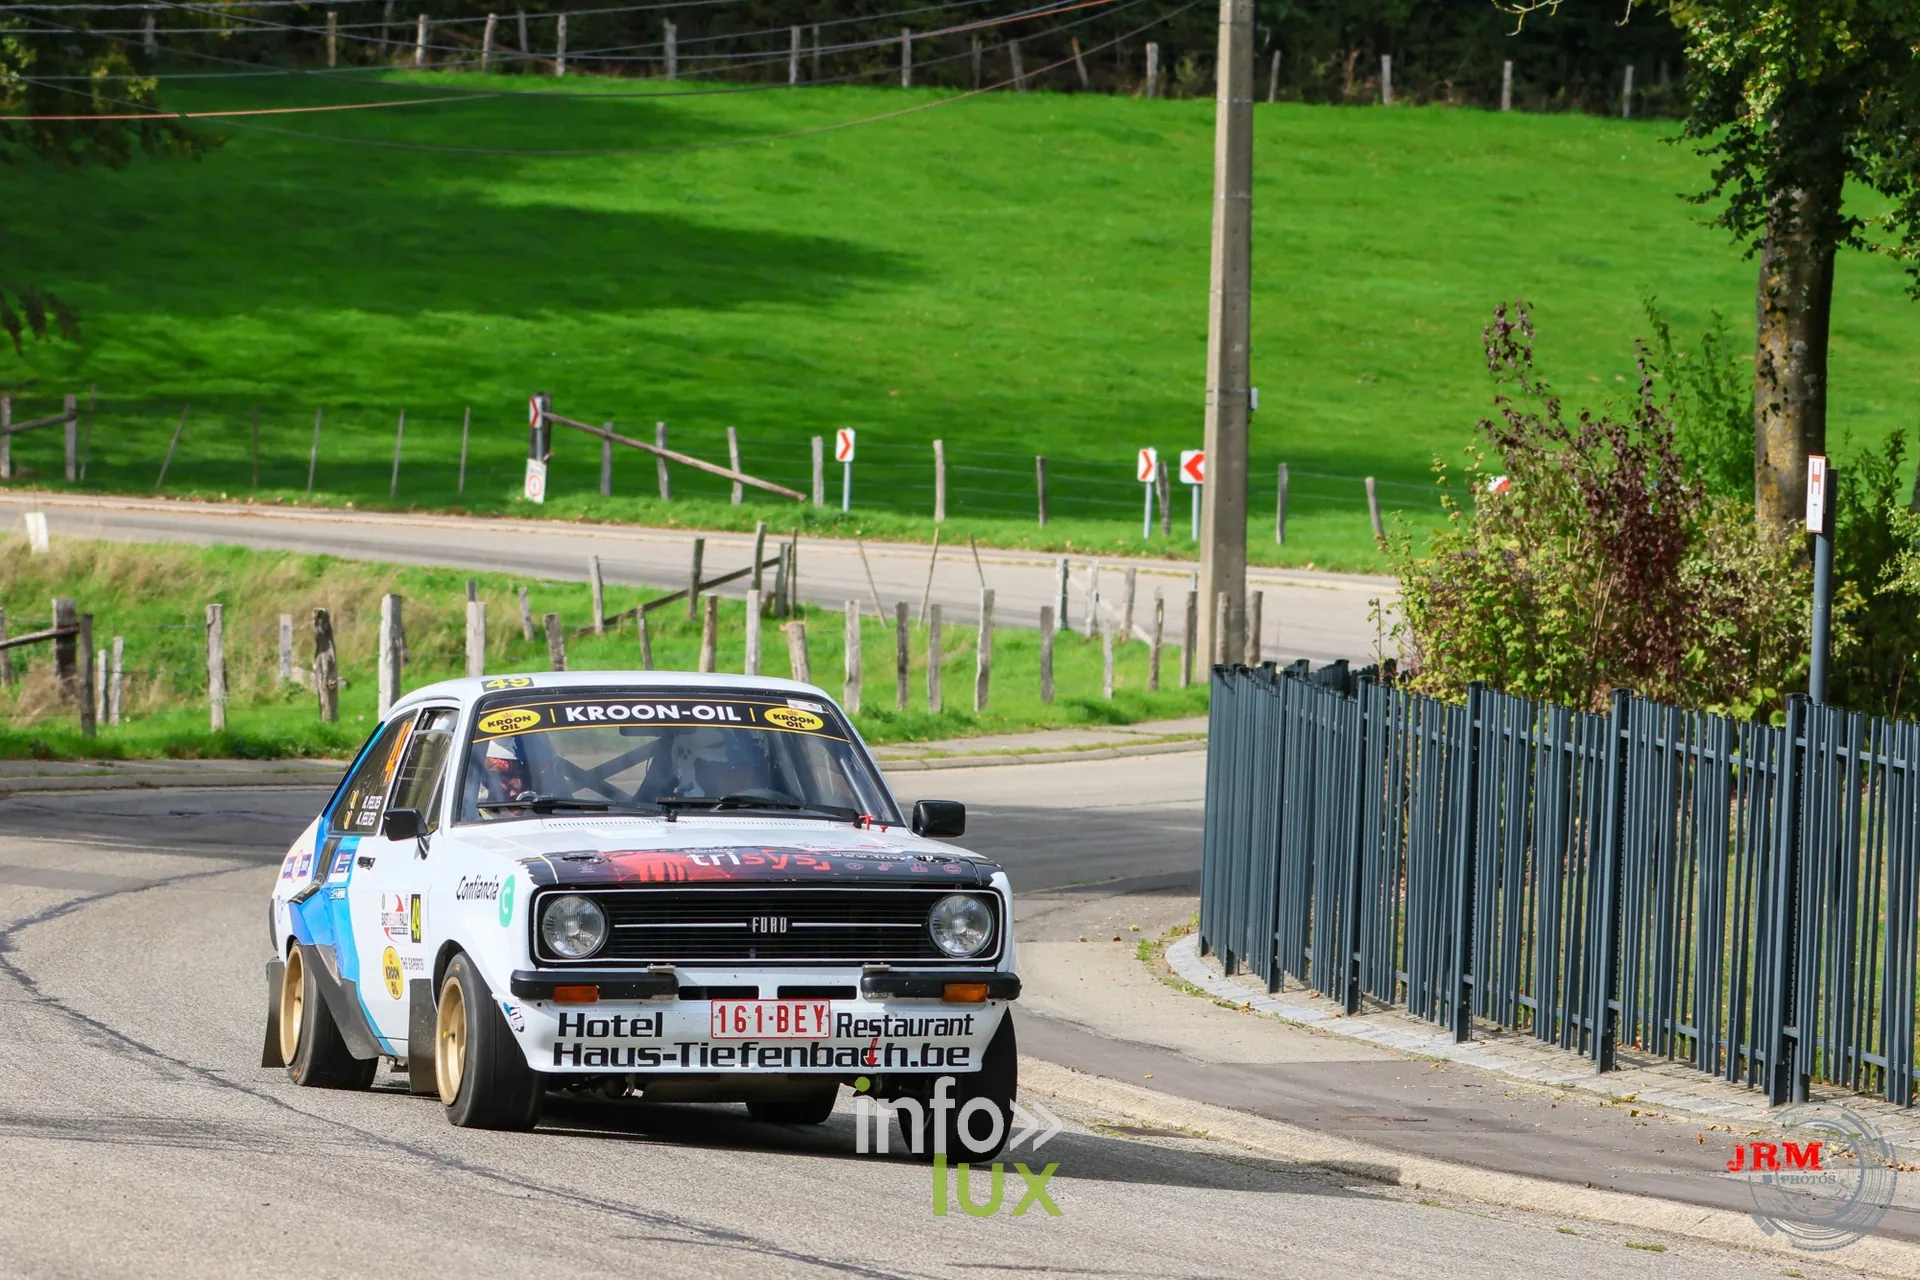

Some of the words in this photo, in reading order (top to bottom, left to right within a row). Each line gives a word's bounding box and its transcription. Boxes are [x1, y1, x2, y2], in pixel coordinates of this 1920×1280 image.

[486, 677, 531, 689] 49
[565, 704, 742, 722] KROON-OIL
[773, 713, 816, 725] KROON
[487, 715, 531, 728] KROON
[500, 723, 520, 732] OIL
[786, 721, 805, 729] OIL
[411, 898, 421, 940] 49
[752, 916, 787, 933] FORD
[557, 1011, 663, 1038] Hotel
[835, 1013, 974, 1038] Restaurant
[553, 1041, 970, 1068] Haus-Tiefenbach.be
